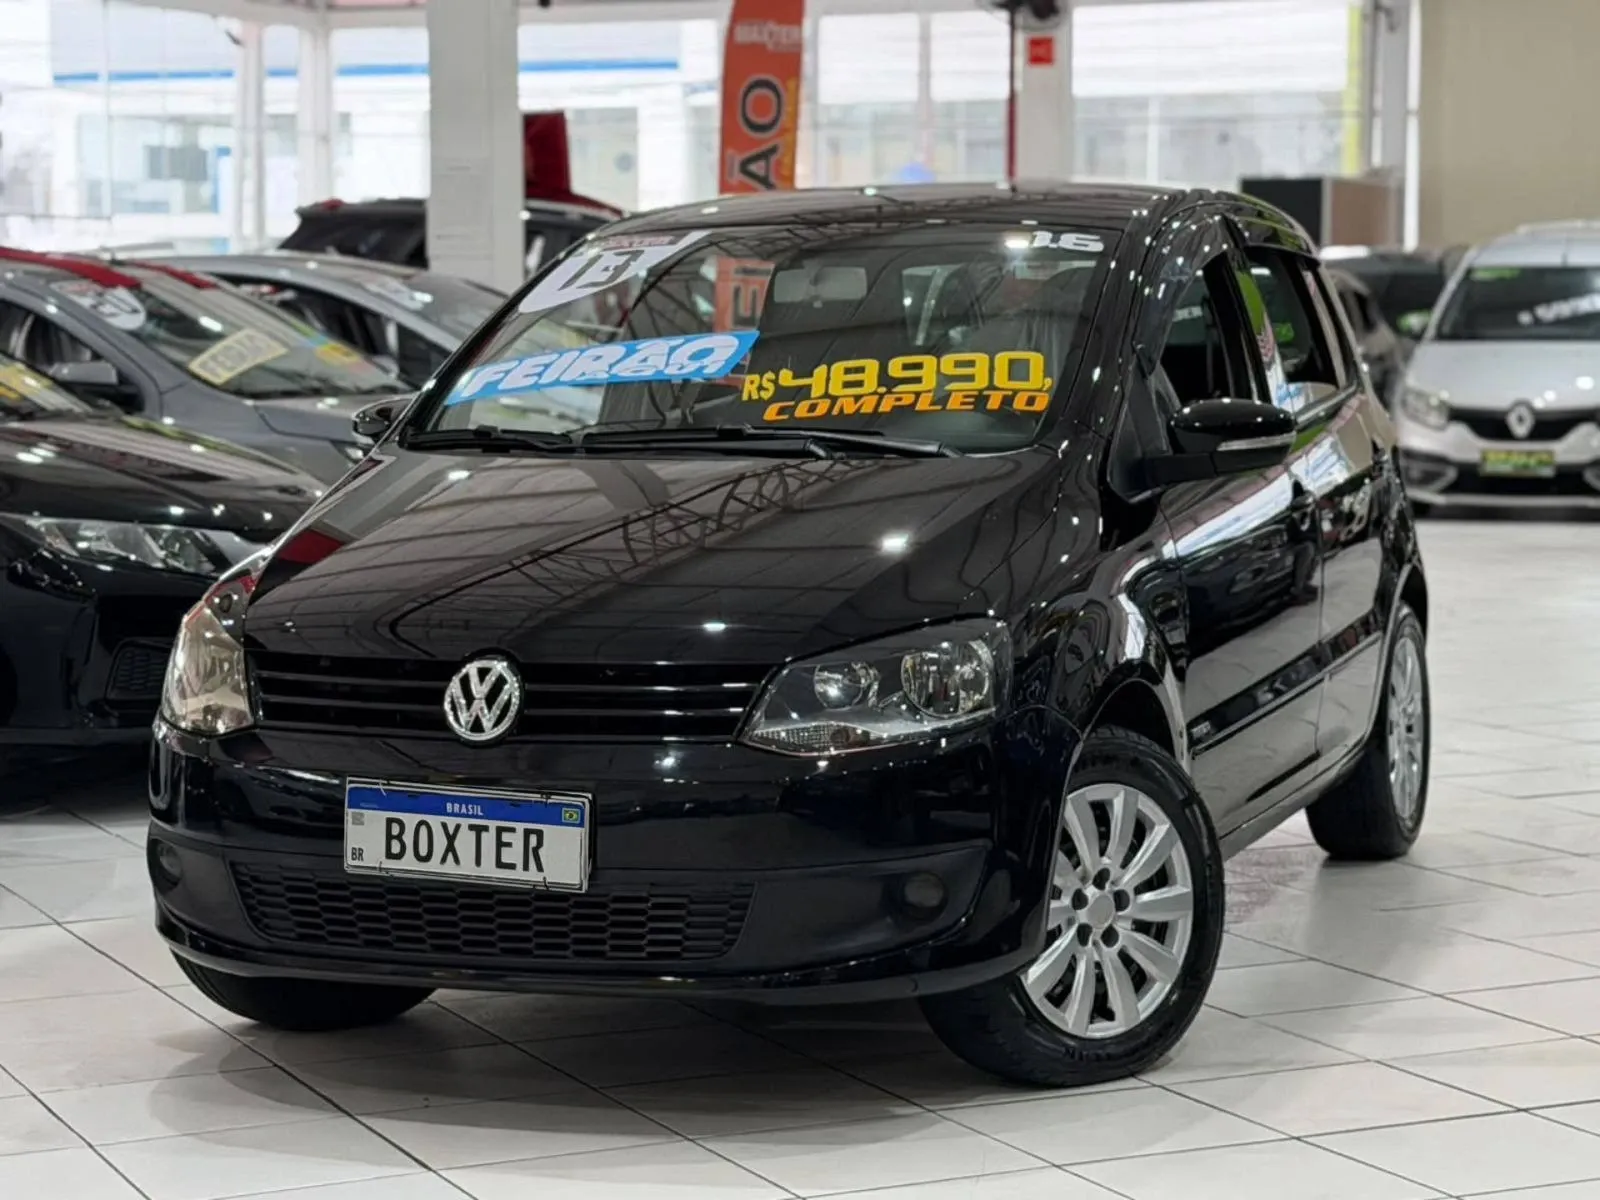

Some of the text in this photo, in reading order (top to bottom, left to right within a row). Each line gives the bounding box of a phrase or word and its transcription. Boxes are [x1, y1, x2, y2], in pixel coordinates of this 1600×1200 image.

[460, 335, 740, 397] FEIRÃO
[742, 371, 775, 401] R$
[762, 391, 1050, 422] COMPLETO
[446, 802, 485, 816] BRASIL
[350, 847, 364, 862] BR
[385, 816, 545, 873] BOXTER
